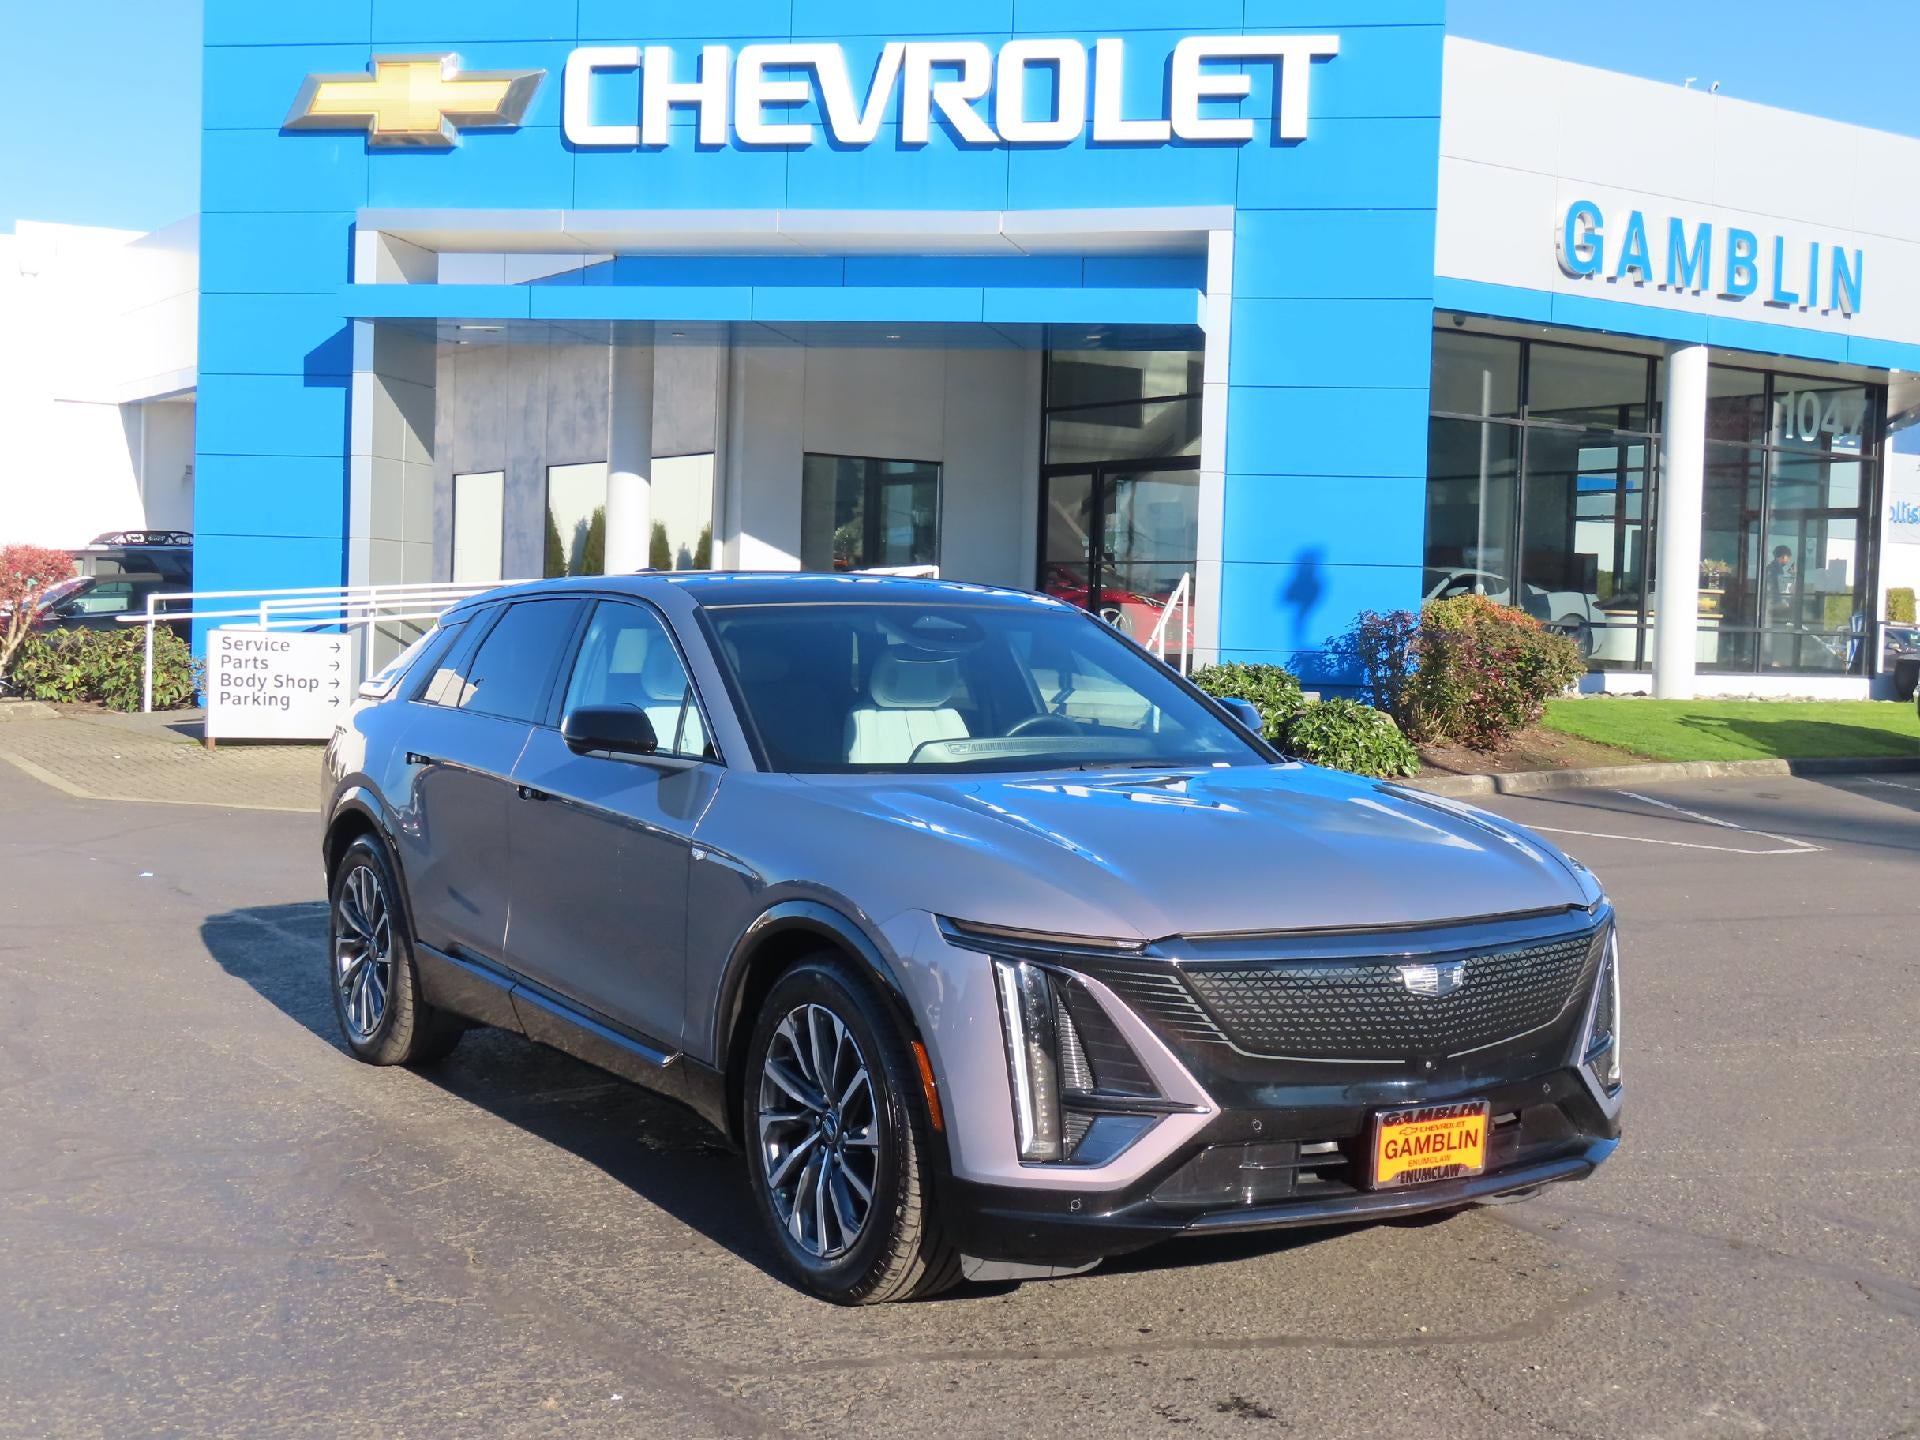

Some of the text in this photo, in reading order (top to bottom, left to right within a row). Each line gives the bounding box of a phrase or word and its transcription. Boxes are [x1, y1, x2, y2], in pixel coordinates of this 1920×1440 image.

[563, 35, 1340, 147] CHEVROLET
[1557, 199, 1863, 316] GAMBLIN
[1778, 390, 1868, 445] 1047
[222, 636, 290, 652] Service
[221, 654, 269, 670] Parts
[220, 673, 319, 692] Body Shop
[220, 691, 290, 711] Parking
[1420, 1120, 1466, 1133] CHEVROLET
[1385, 1128, 1479, 1160] GAMBLIN
[1407, 1154, 1452, 1167] ENUMCLAW
[1400, 1163, 1461, 1183] ENUMCLAW
